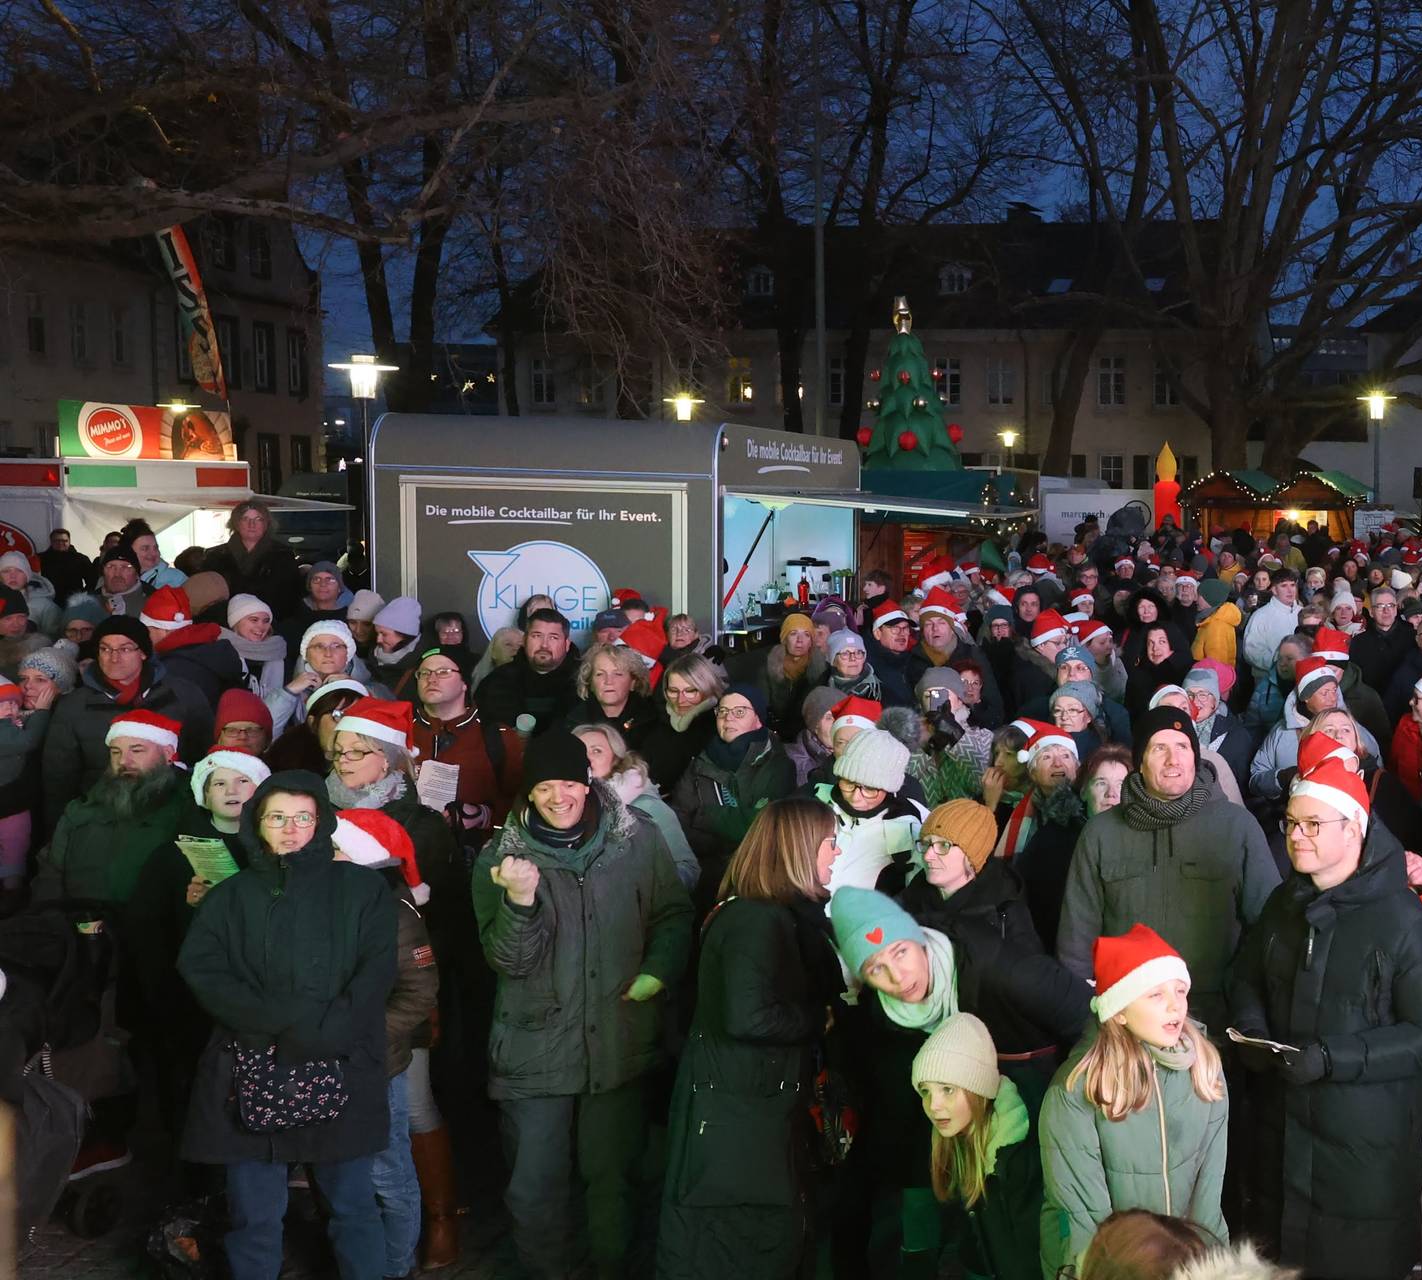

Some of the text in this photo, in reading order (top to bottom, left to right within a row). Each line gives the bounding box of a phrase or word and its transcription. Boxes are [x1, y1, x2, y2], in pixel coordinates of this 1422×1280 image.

[90, 418, 127, 438] MIMMO'S
[747, 439, 758, 459] Die
[759, 440, 780, 461] mobile
[780, 442, 811, 463] Cocktailbar
[425, 505, 662, 523] Die mobile Cocktailbar für Ihr Event.
